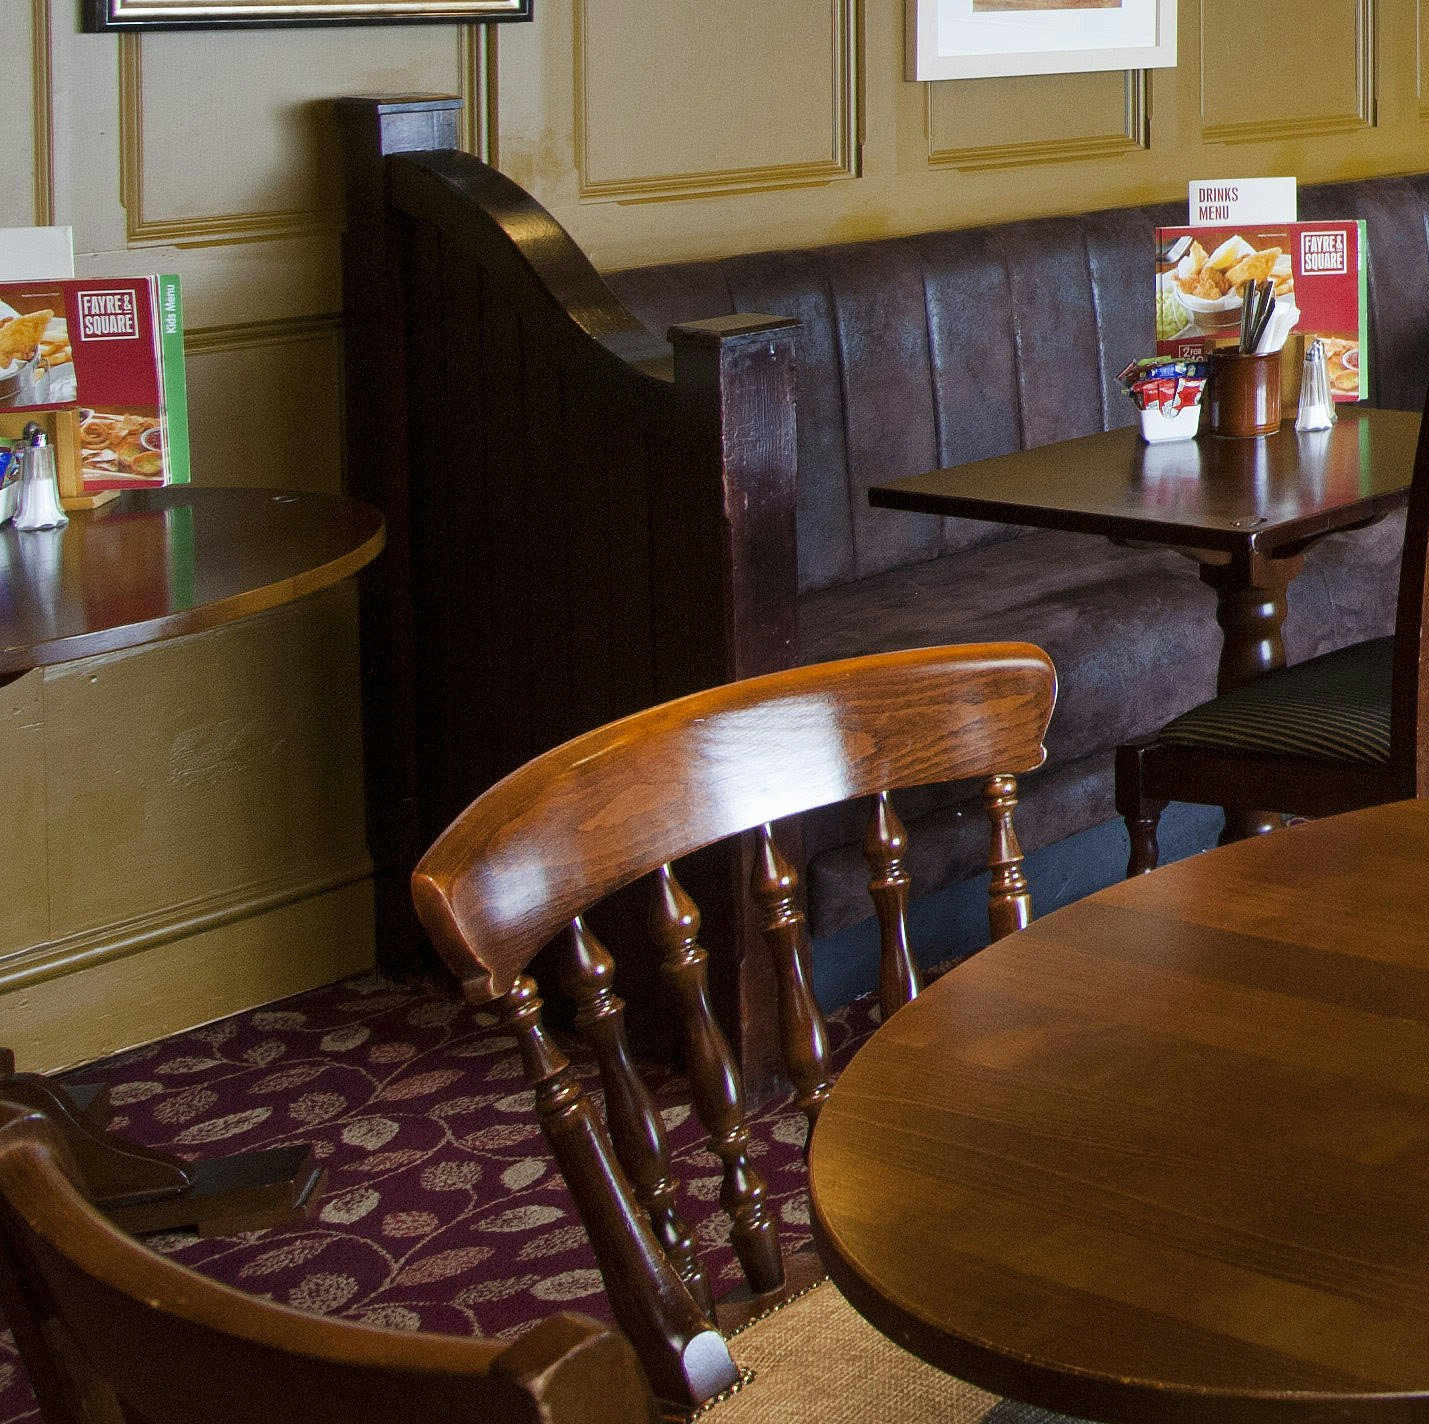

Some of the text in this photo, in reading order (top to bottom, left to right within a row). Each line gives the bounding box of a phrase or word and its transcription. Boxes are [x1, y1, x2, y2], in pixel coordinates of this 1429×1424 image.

[1199, 187, 1239, 203] DRINKS
[1199, 205, 1229, 221] MENU
[1305, 235, 1343, 253] FAYRE &
[1305, 252, 1343, 270] SQUARE
[83, 294, 132, 315] FAYRE &
[164, 284, 177, 334] Kids Menu
[84, 314, 133, 336] SQUARE
